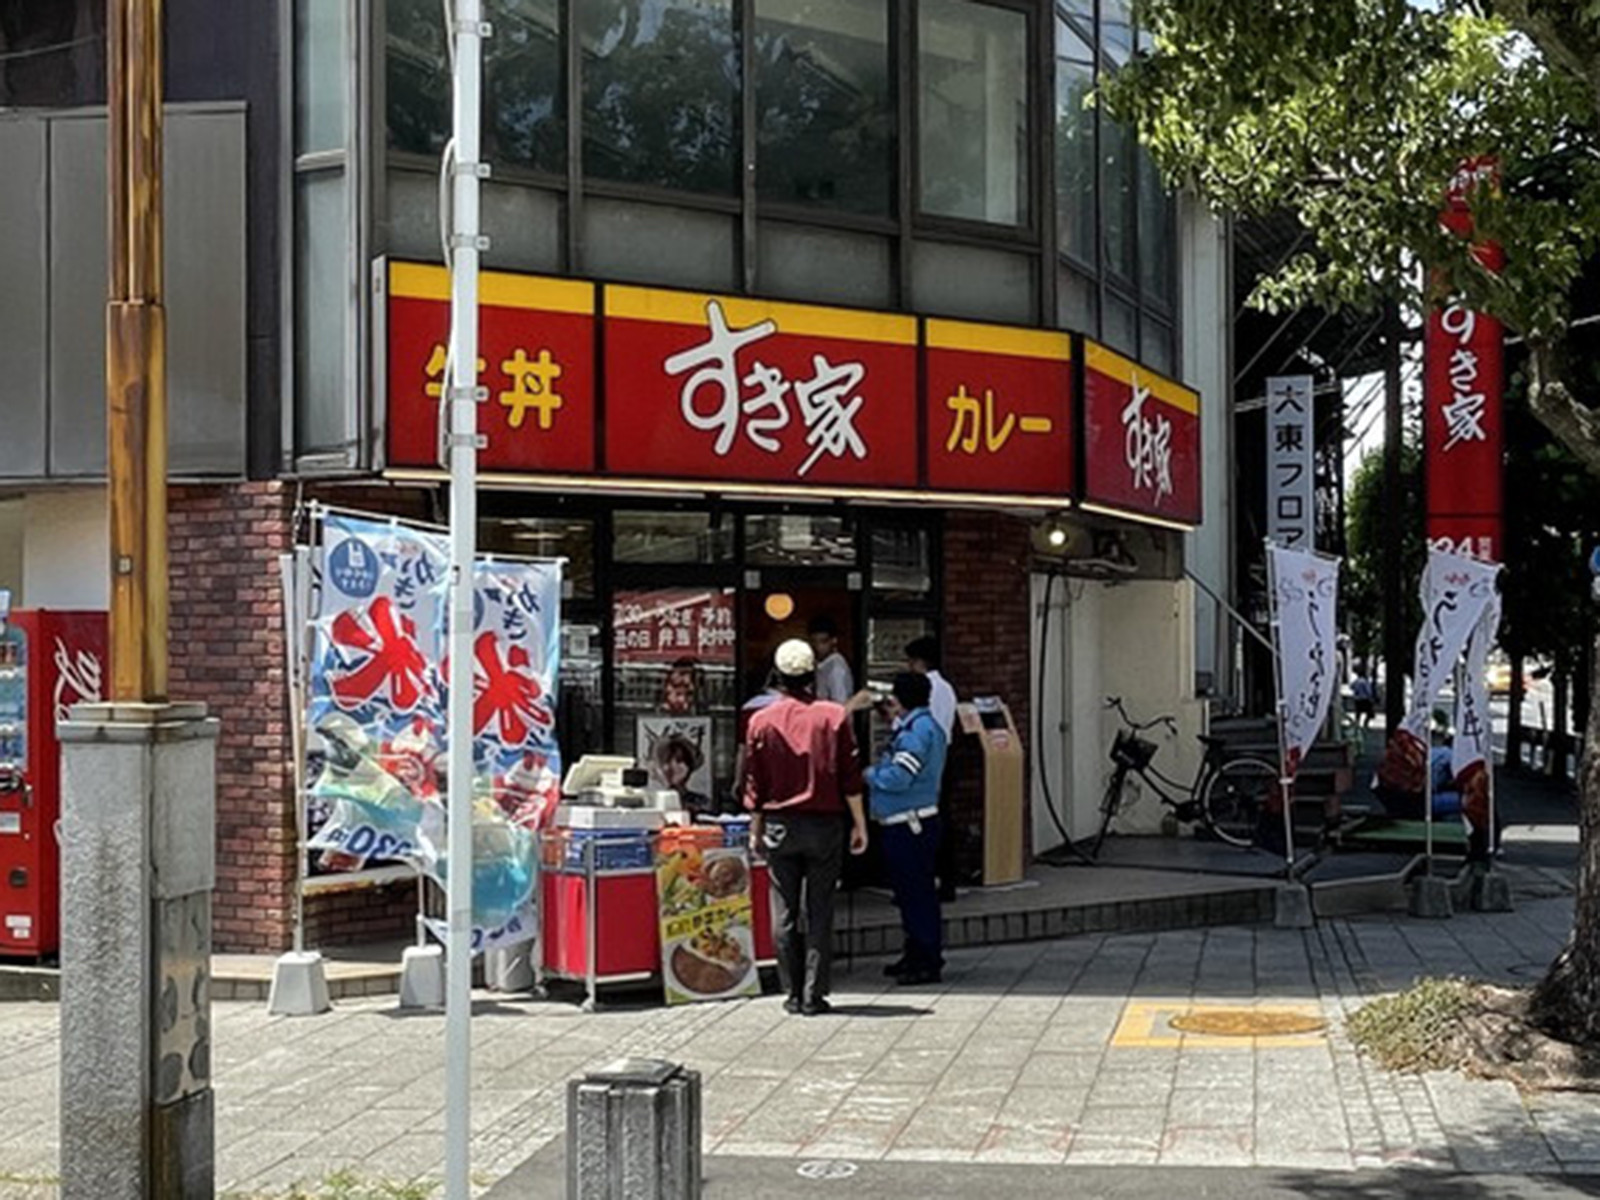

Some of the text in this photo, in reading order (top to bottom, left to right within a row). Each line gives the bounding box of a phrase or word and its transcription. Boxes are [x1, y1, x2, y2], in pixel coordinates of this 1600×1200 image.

[663, 298, 868, 478] すき家
[945, 383, 1052, 454] カレー
